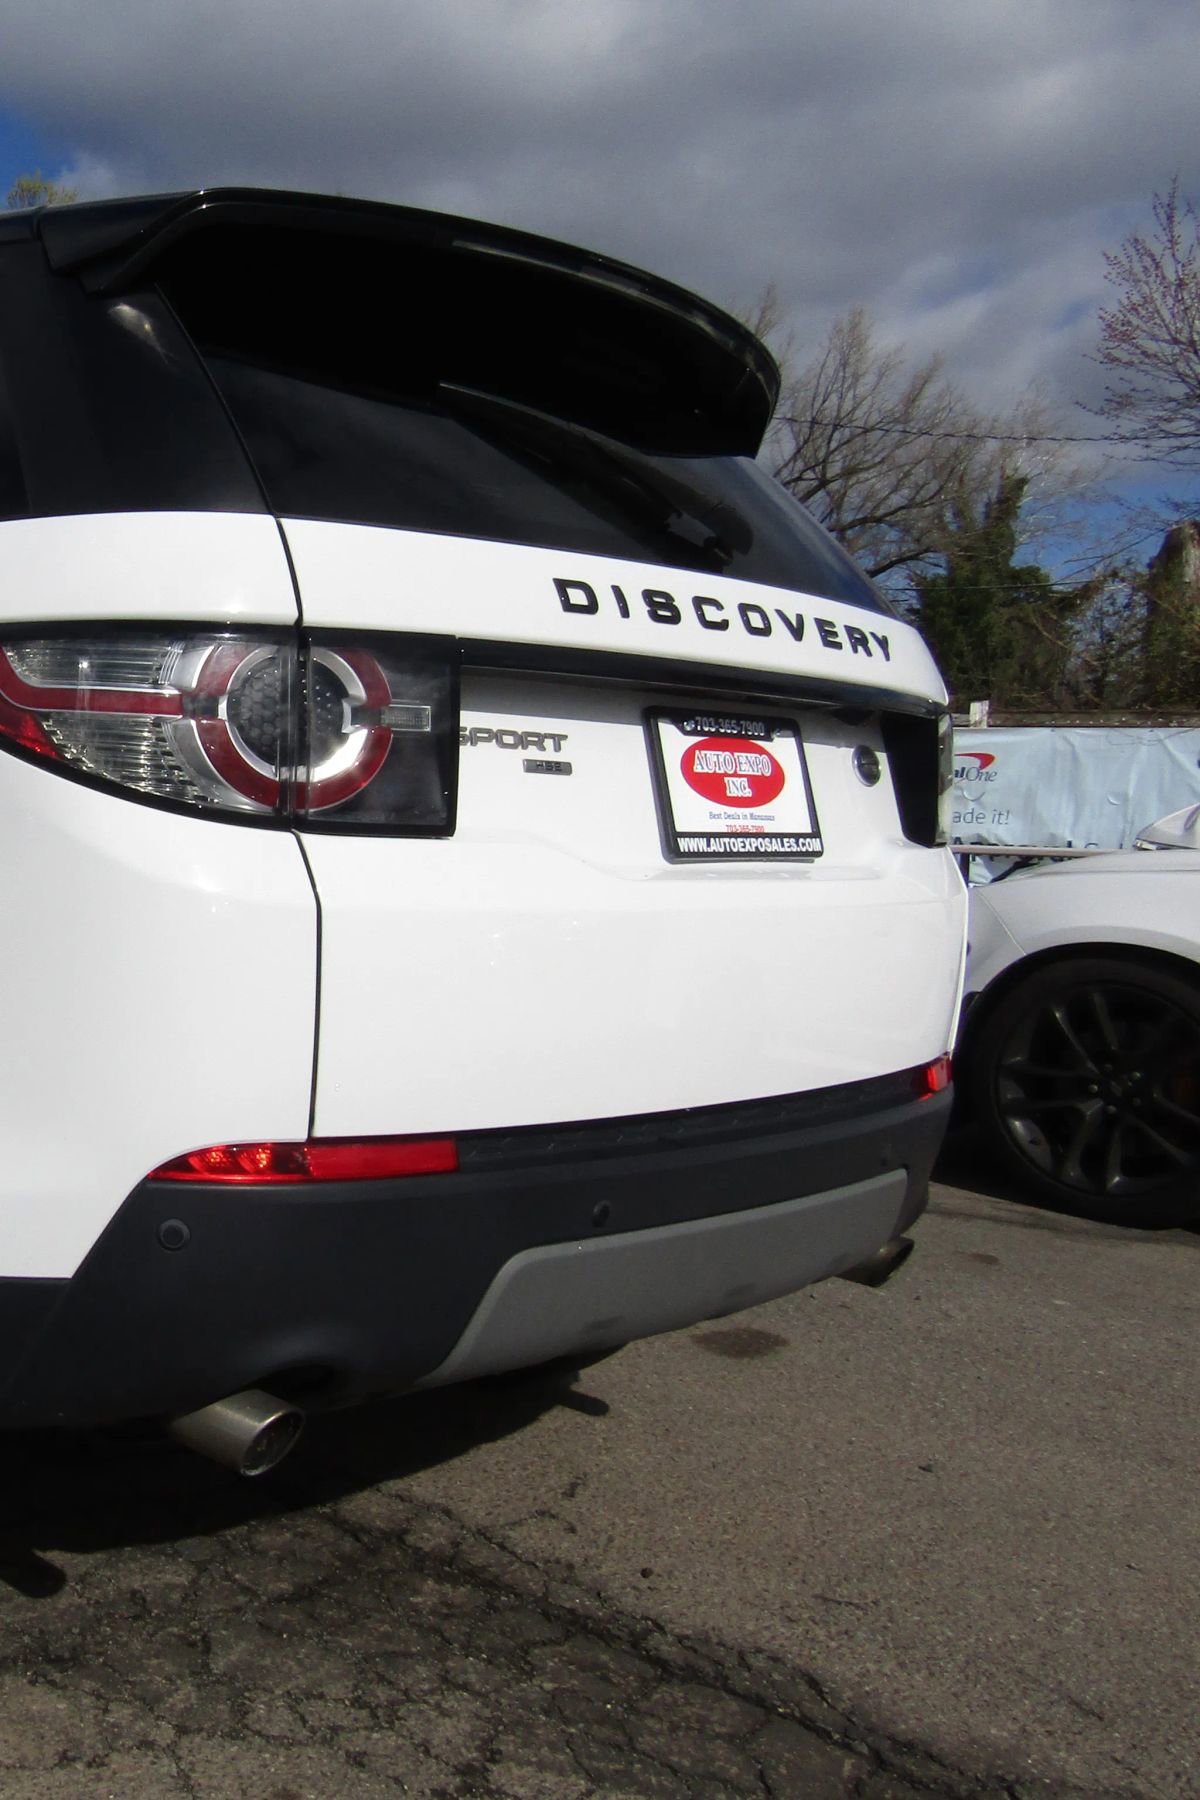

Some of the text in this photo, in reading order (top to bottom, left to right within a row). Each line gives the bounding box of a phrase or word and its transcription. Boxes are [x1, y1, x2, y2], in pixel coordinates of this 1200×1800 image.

[552, 577, 891, 662] DISCOVERY
[695, 716, 765, 737] 703-365-7900
[693, 750, 772, 776] AUTO EXPO
[724, 777, 752, 797] INC.
[991, 808, 1010, 825] it!
[677, 837, 822, 853] WWW.AUTOEXPOSALES.COM
